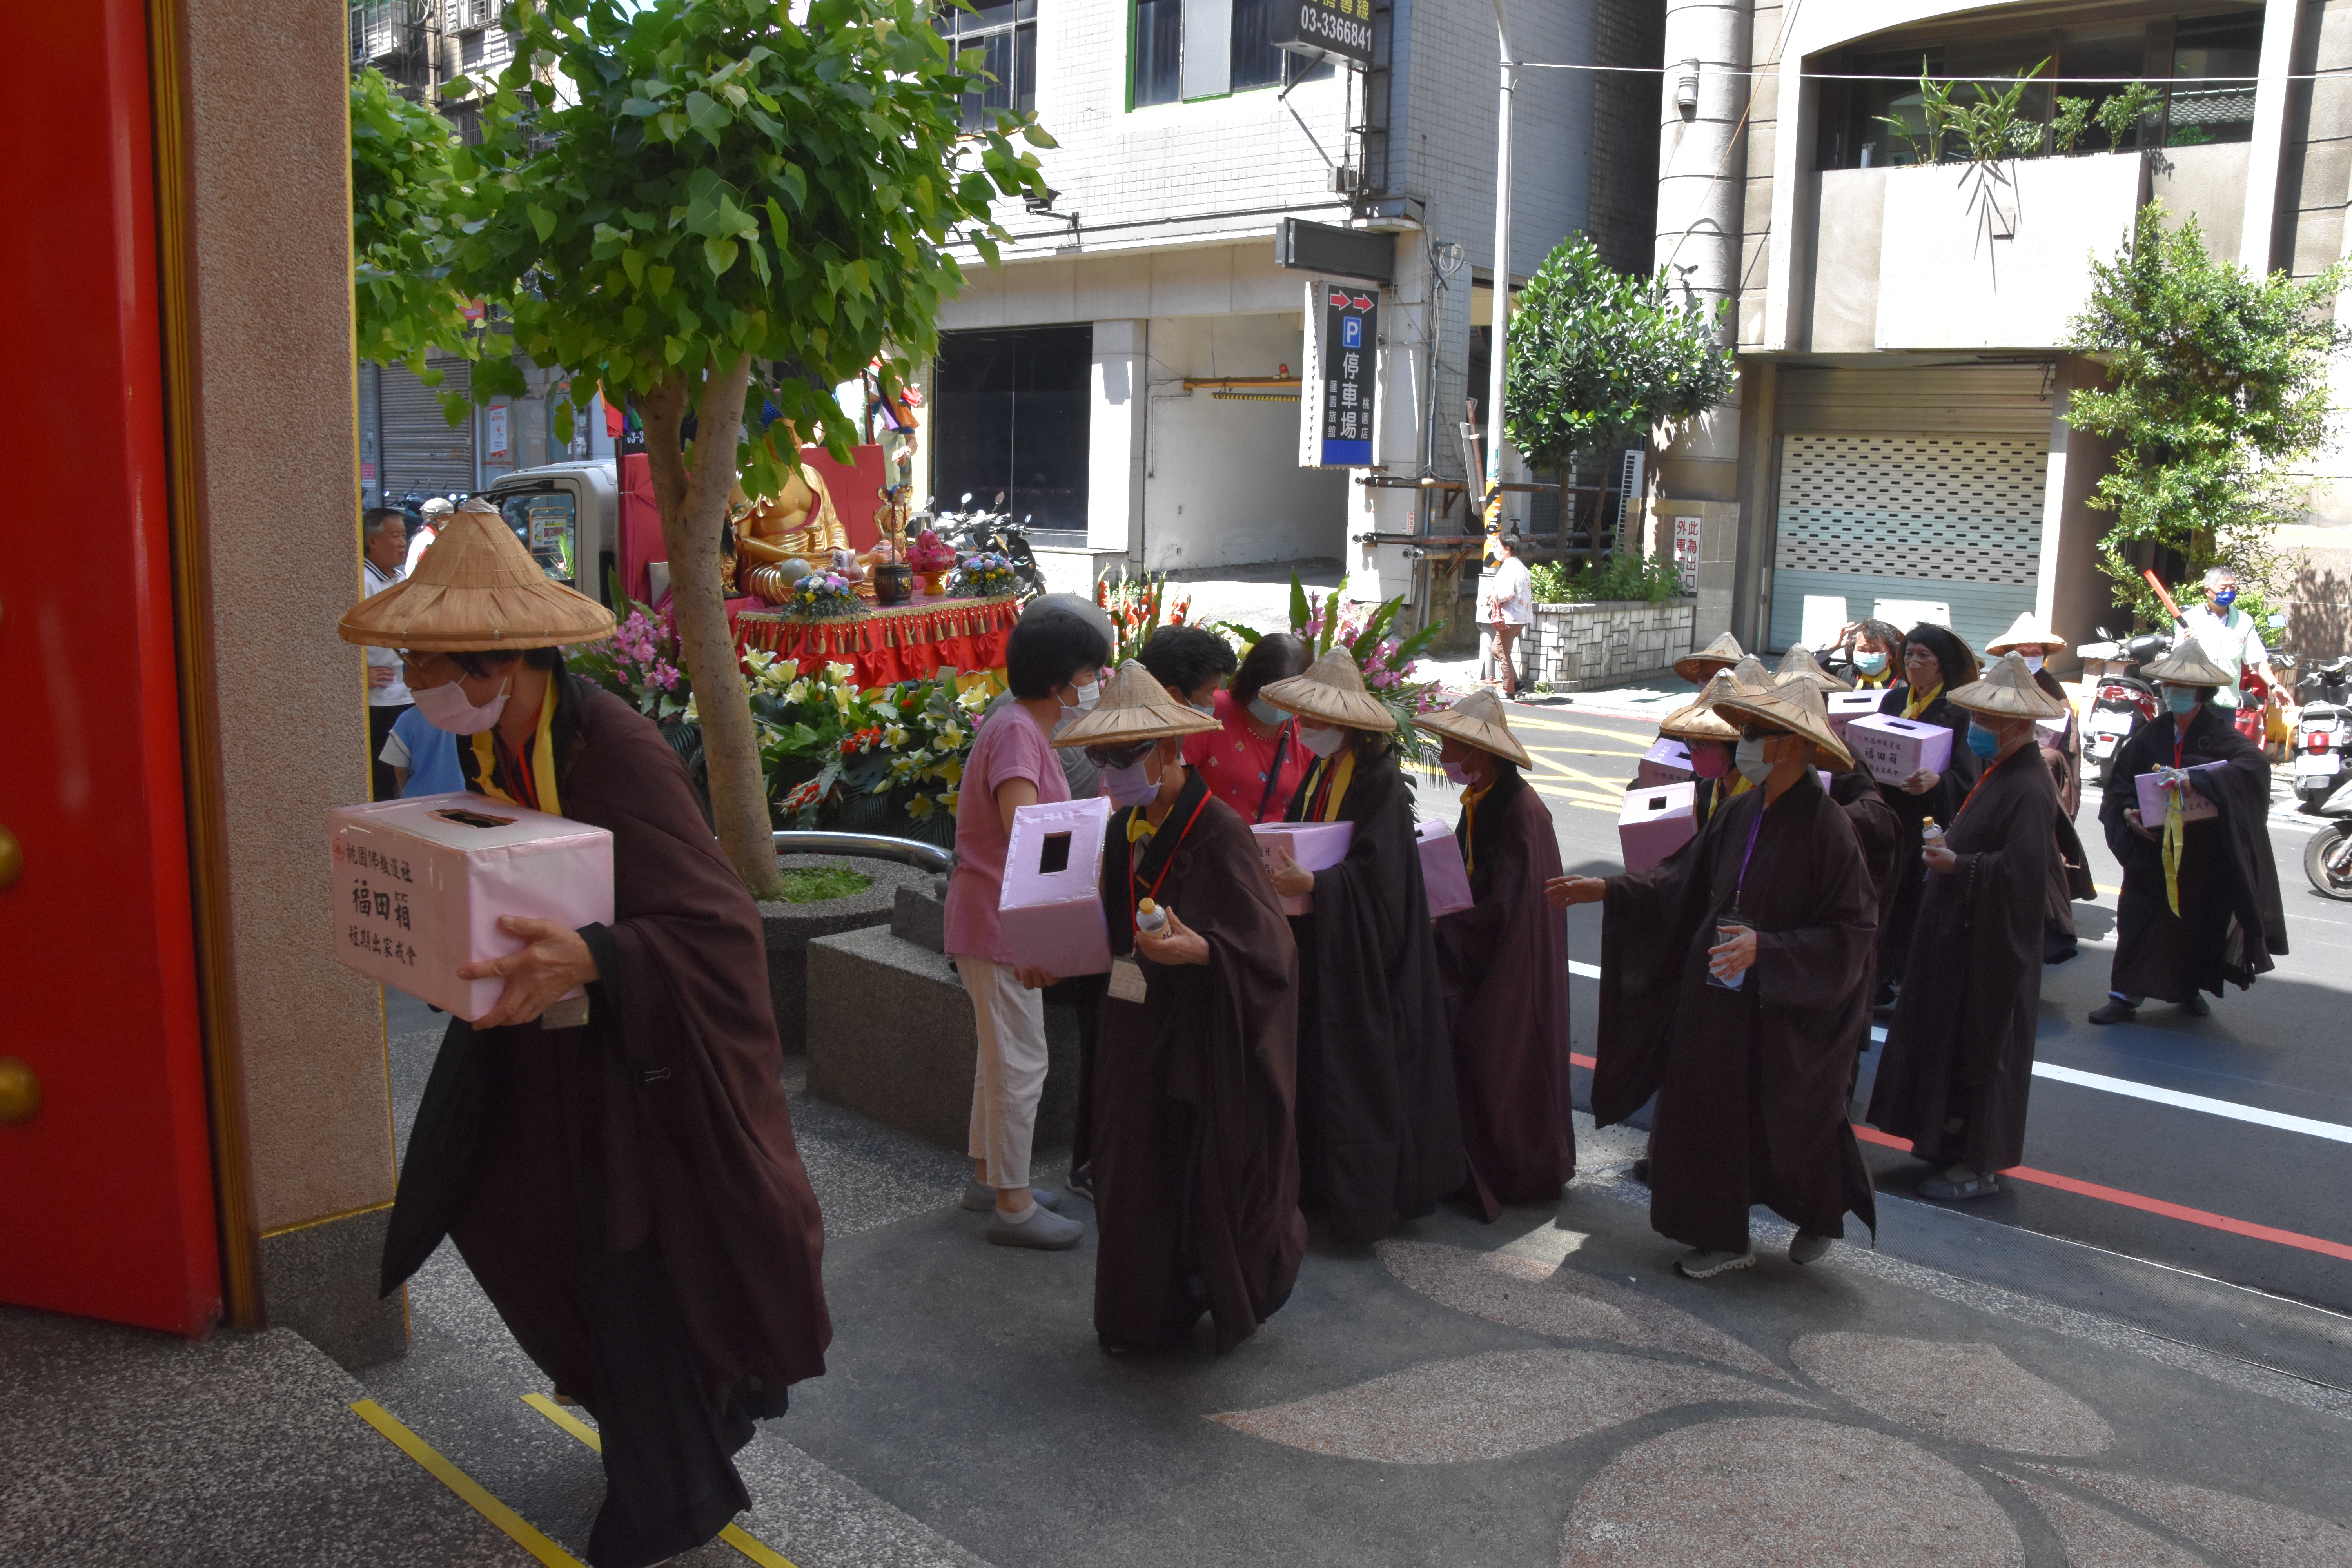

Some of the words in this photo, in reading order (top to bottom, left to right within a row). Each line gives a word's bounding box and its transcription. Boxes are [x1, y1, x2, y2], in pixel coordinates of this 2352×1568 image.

[1301, 5, 1371, 51] 03-3366841
[1347, 321, 1358, 343] P
[1340, 352, 1359, 439] 停車場
[1361, 397, 1370, 439] 桃園店
[1686, 521, 1698, 588] 此為出口
[1865, 748, 1897, 765] 福田箱
[347, 842, 413, 883] 桃園佛教蓮社
[352, 879, 410, 931] 福田箱
